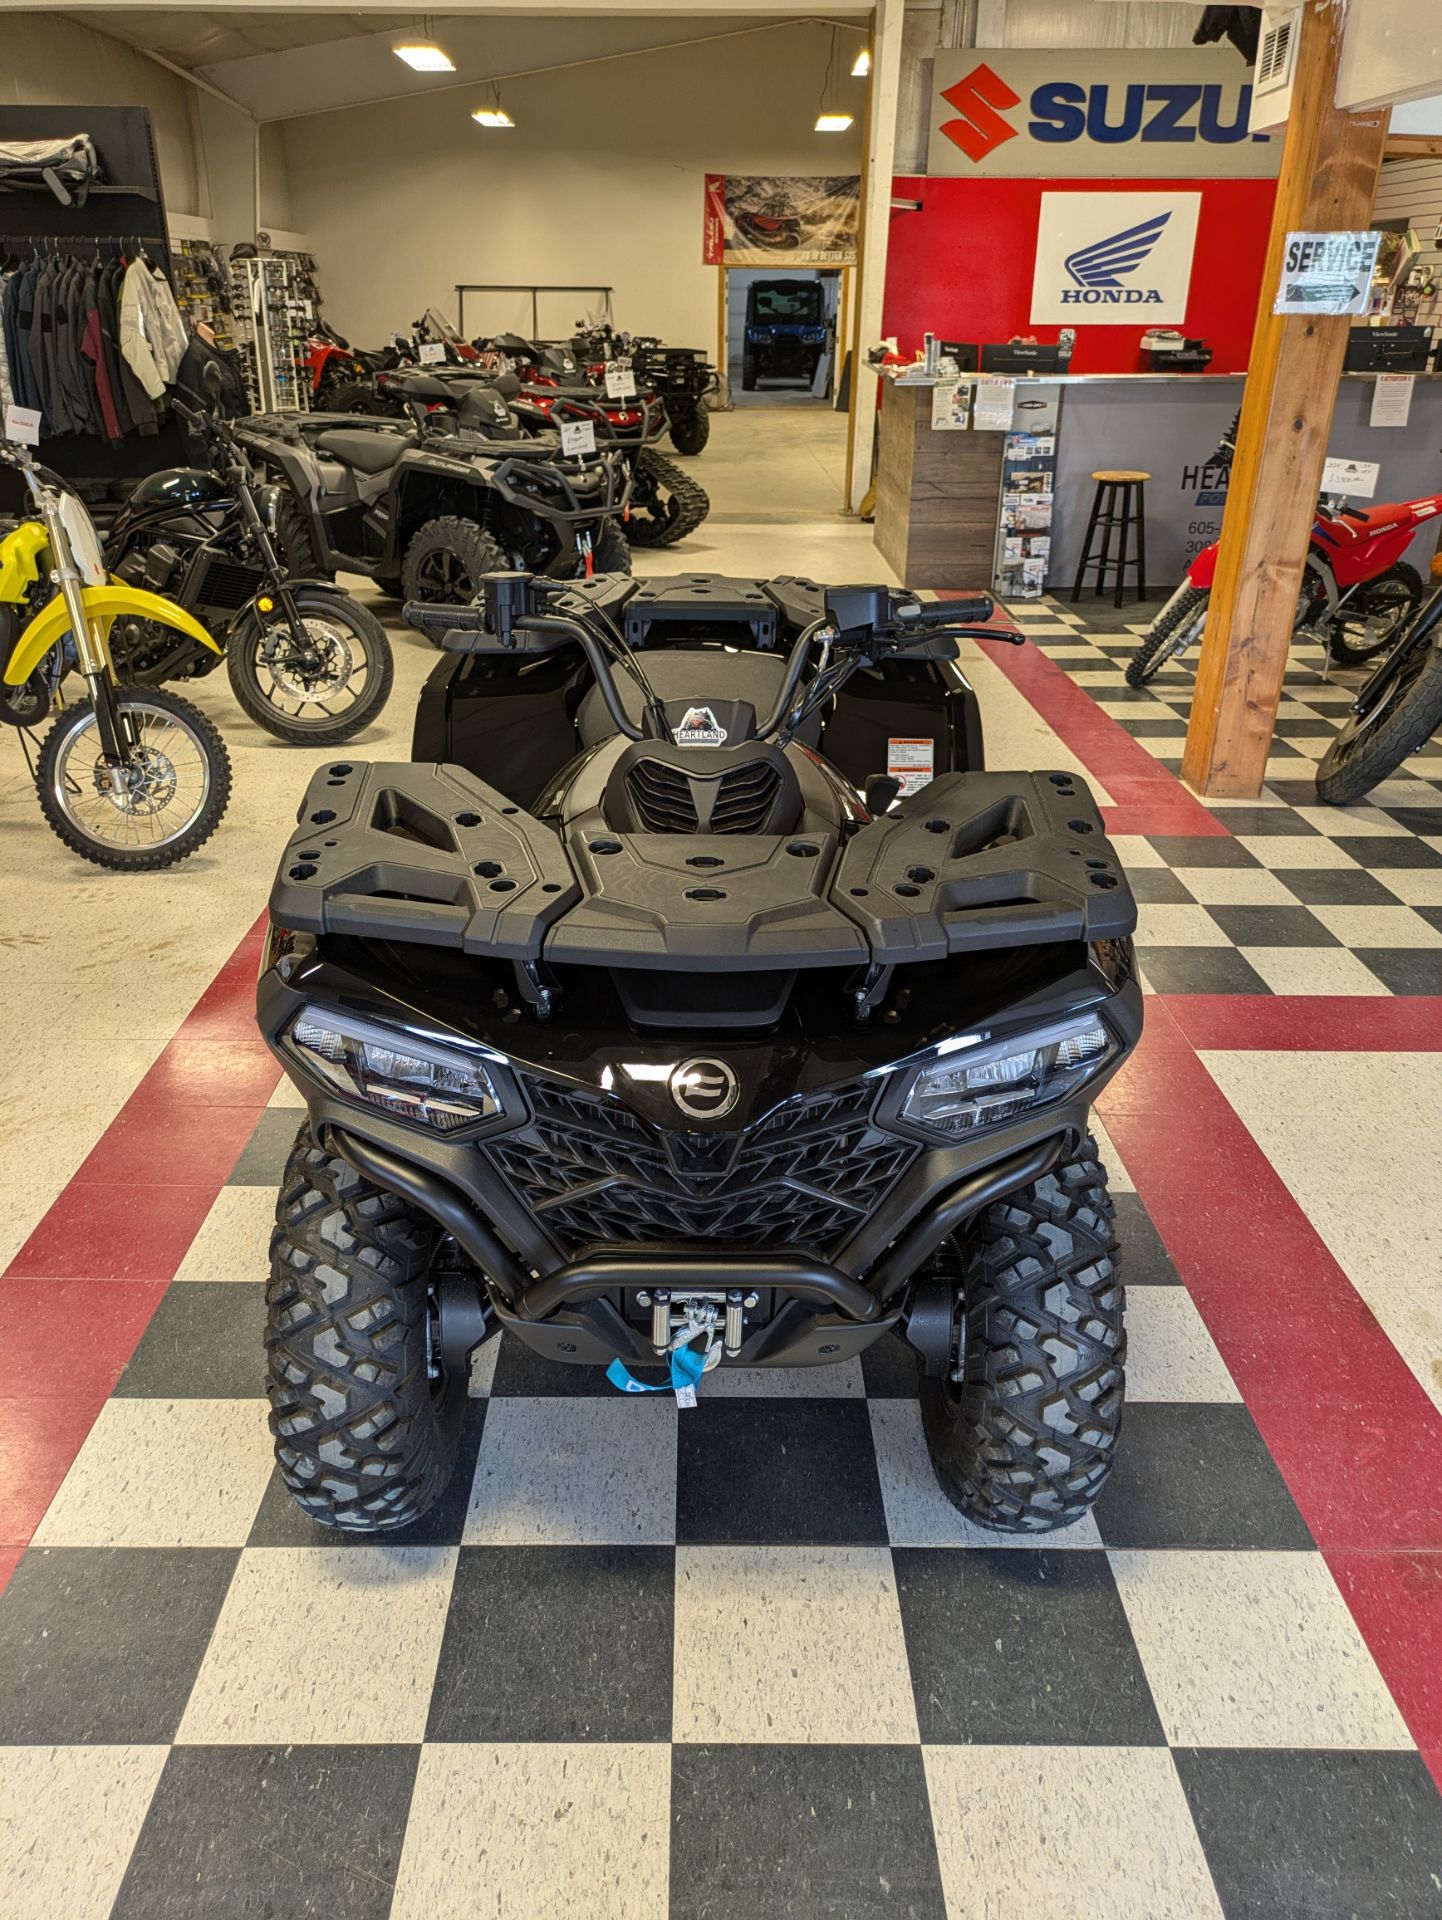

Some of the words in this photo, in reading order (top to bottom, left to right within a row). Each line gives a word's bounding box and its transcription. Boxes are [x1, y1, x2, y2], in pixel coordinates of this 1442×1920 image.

[1028, 82, 1270, 144] SUZU
[1286, 241, 1376, 273] SERVICE
[1060, 289, 1164, 304] HONDA
[428, 459, 471, 475] OUTLANDER
[1181, 465, 1230, 490] HEA
[1369, 522, 1398, 537] HONDA
[674, 730, 726, 738] HEARTLAND
